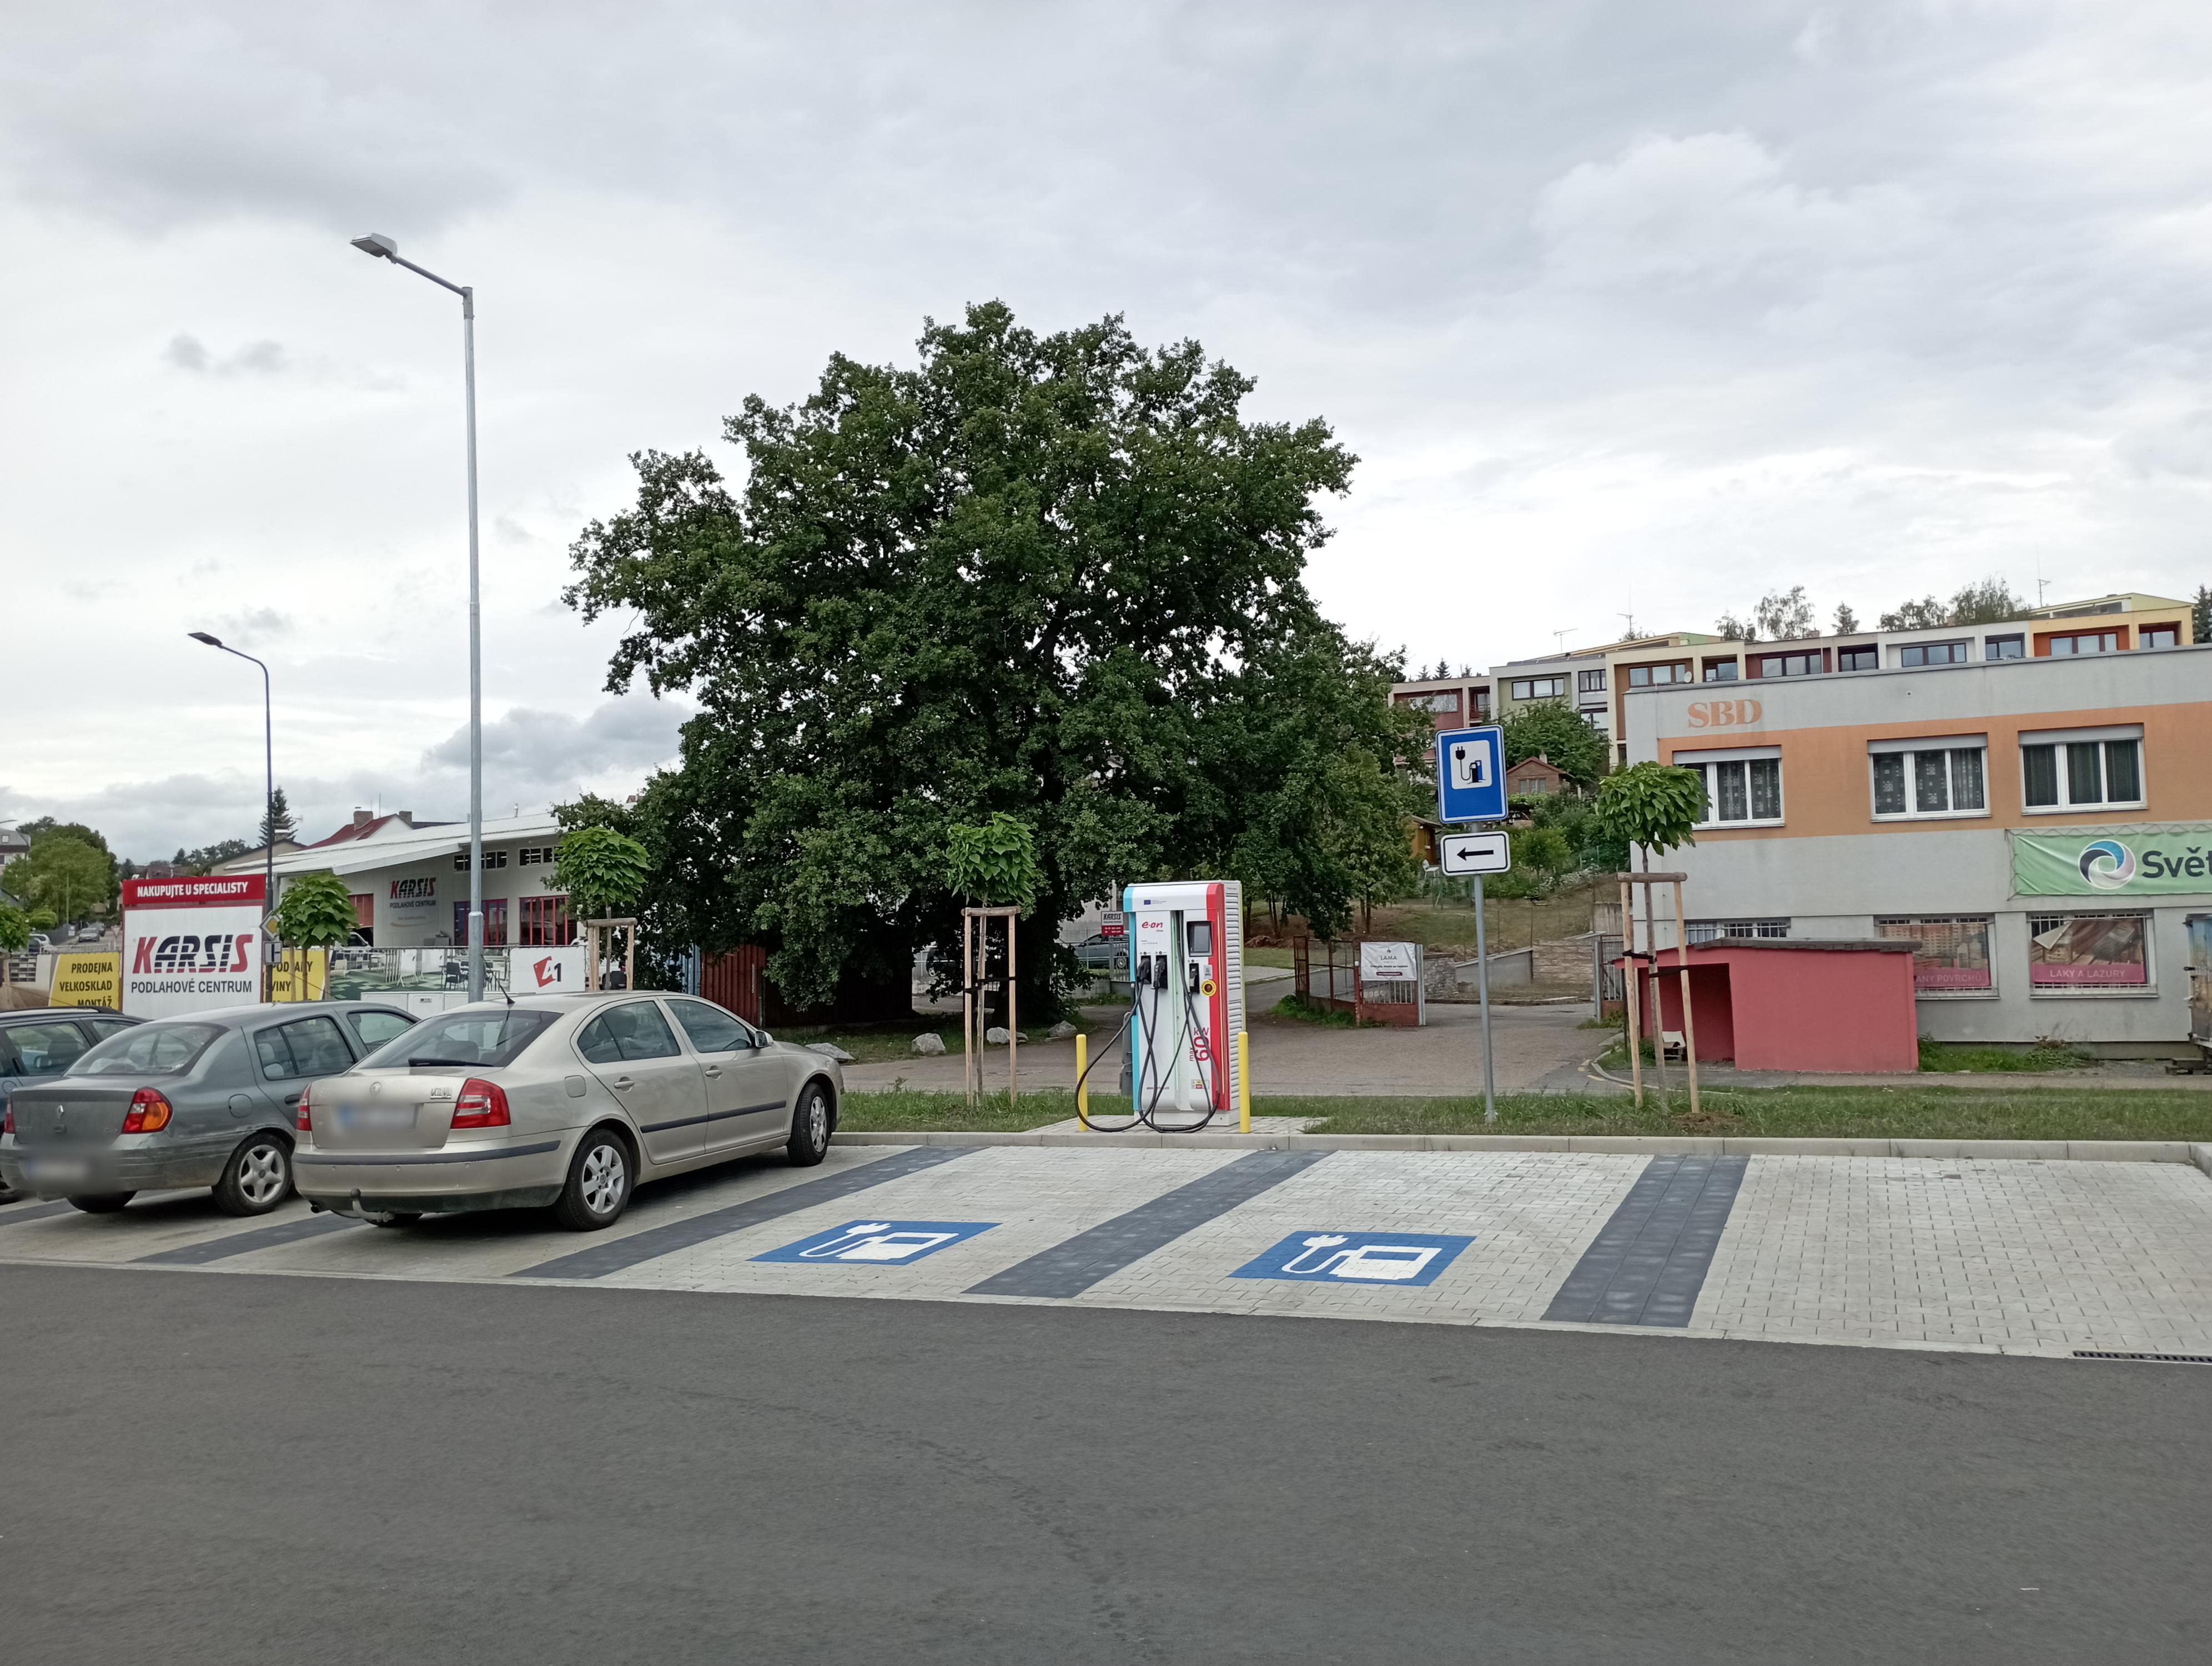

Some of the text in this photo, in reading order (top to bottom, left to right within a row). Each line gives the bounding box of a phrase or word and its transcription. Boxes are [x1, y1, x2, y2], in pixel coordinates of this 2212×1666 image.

[1688, 699, 1762, 728] SBD
[2141, 846, 2212, 878] Svět
[137, 884, 184, 898] NAKUPUJTE
[193, 882, 248, 894] SPECIALISTY
[390, 877, 436, 899] KARSIS
[132, 934, 254, 974] KARSIS
[71, 962, 113, 975] PRODEJNA
[1937, 972, 1982, 982] POVRCHŮ
[59, 980, 112, 992] VELKOSKLAD
[132, 978, 252, 993] PODLAHOVÉ CENTRUM
[1194, 1027, 1209, 1036] kW
